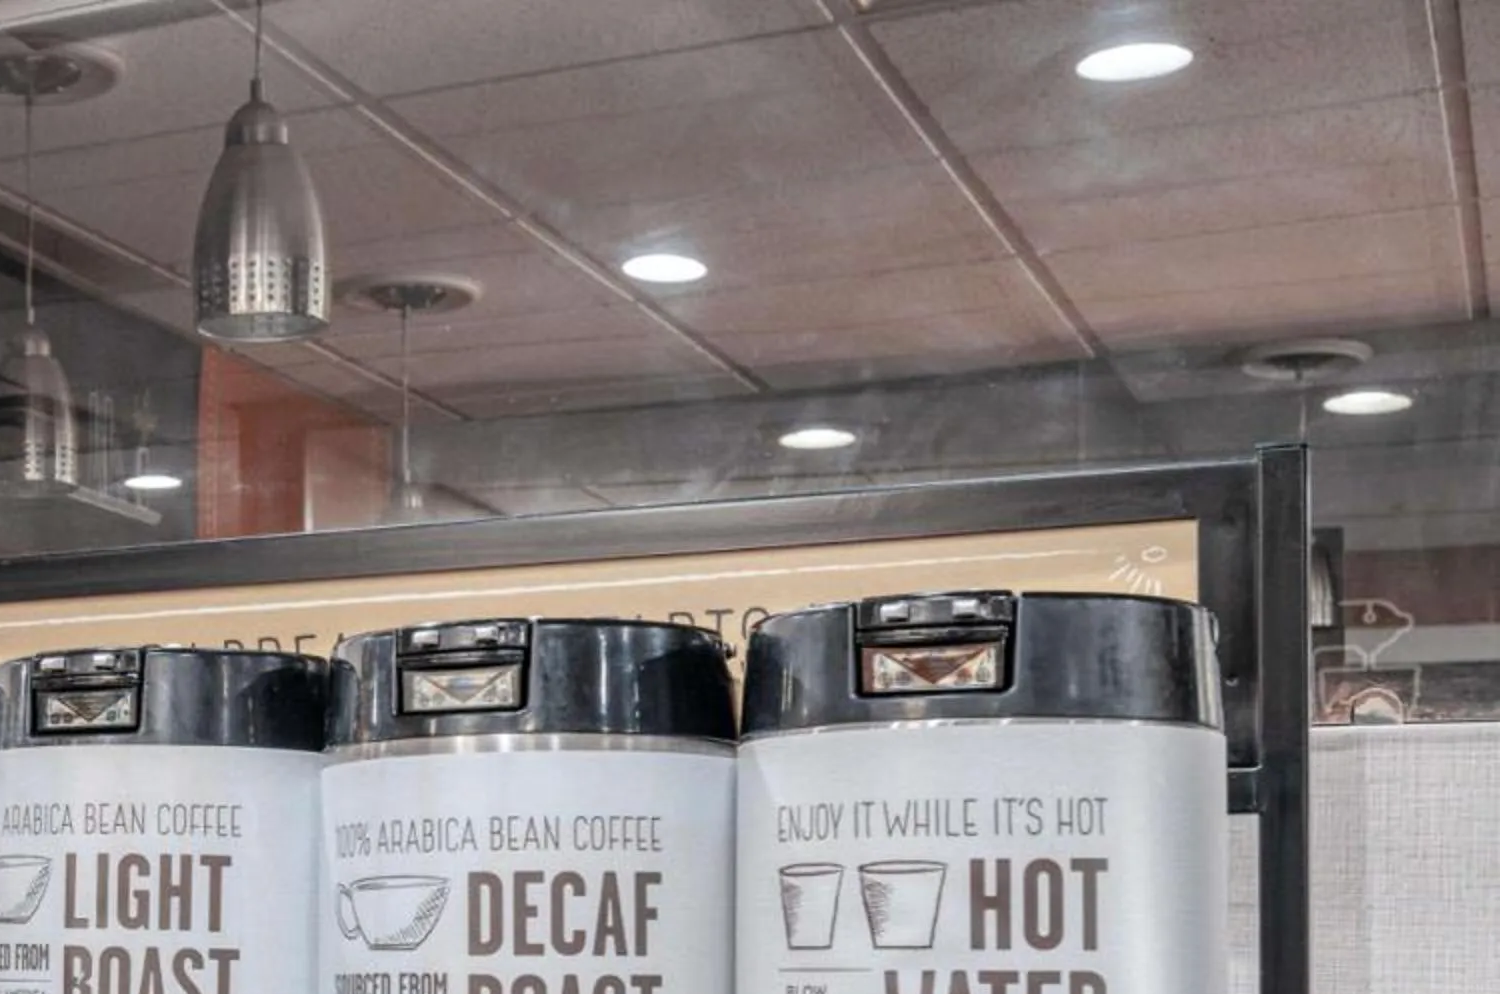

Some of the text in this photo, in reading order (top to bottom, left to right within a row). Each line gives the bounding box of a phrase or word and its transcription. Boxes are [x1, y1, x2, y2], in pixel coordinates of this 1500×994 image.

[2, 804, 75, 837] ARABICA
[83, 803, 146, 836] BEAN
[157, 804, 242, 838] COFFEE
[335, 816, 664, 858] 100% ARABICA BEAN COFFEE
[777, 797, 1109, 843] ENJOY IT WHILE IT'S HOT
[63, 853, 233, 933] LIGHT
[467, 870, 663, 957] DECAF
[969, 858, 1109, 951] HOT
[14, 943, 50, 970] FROM
